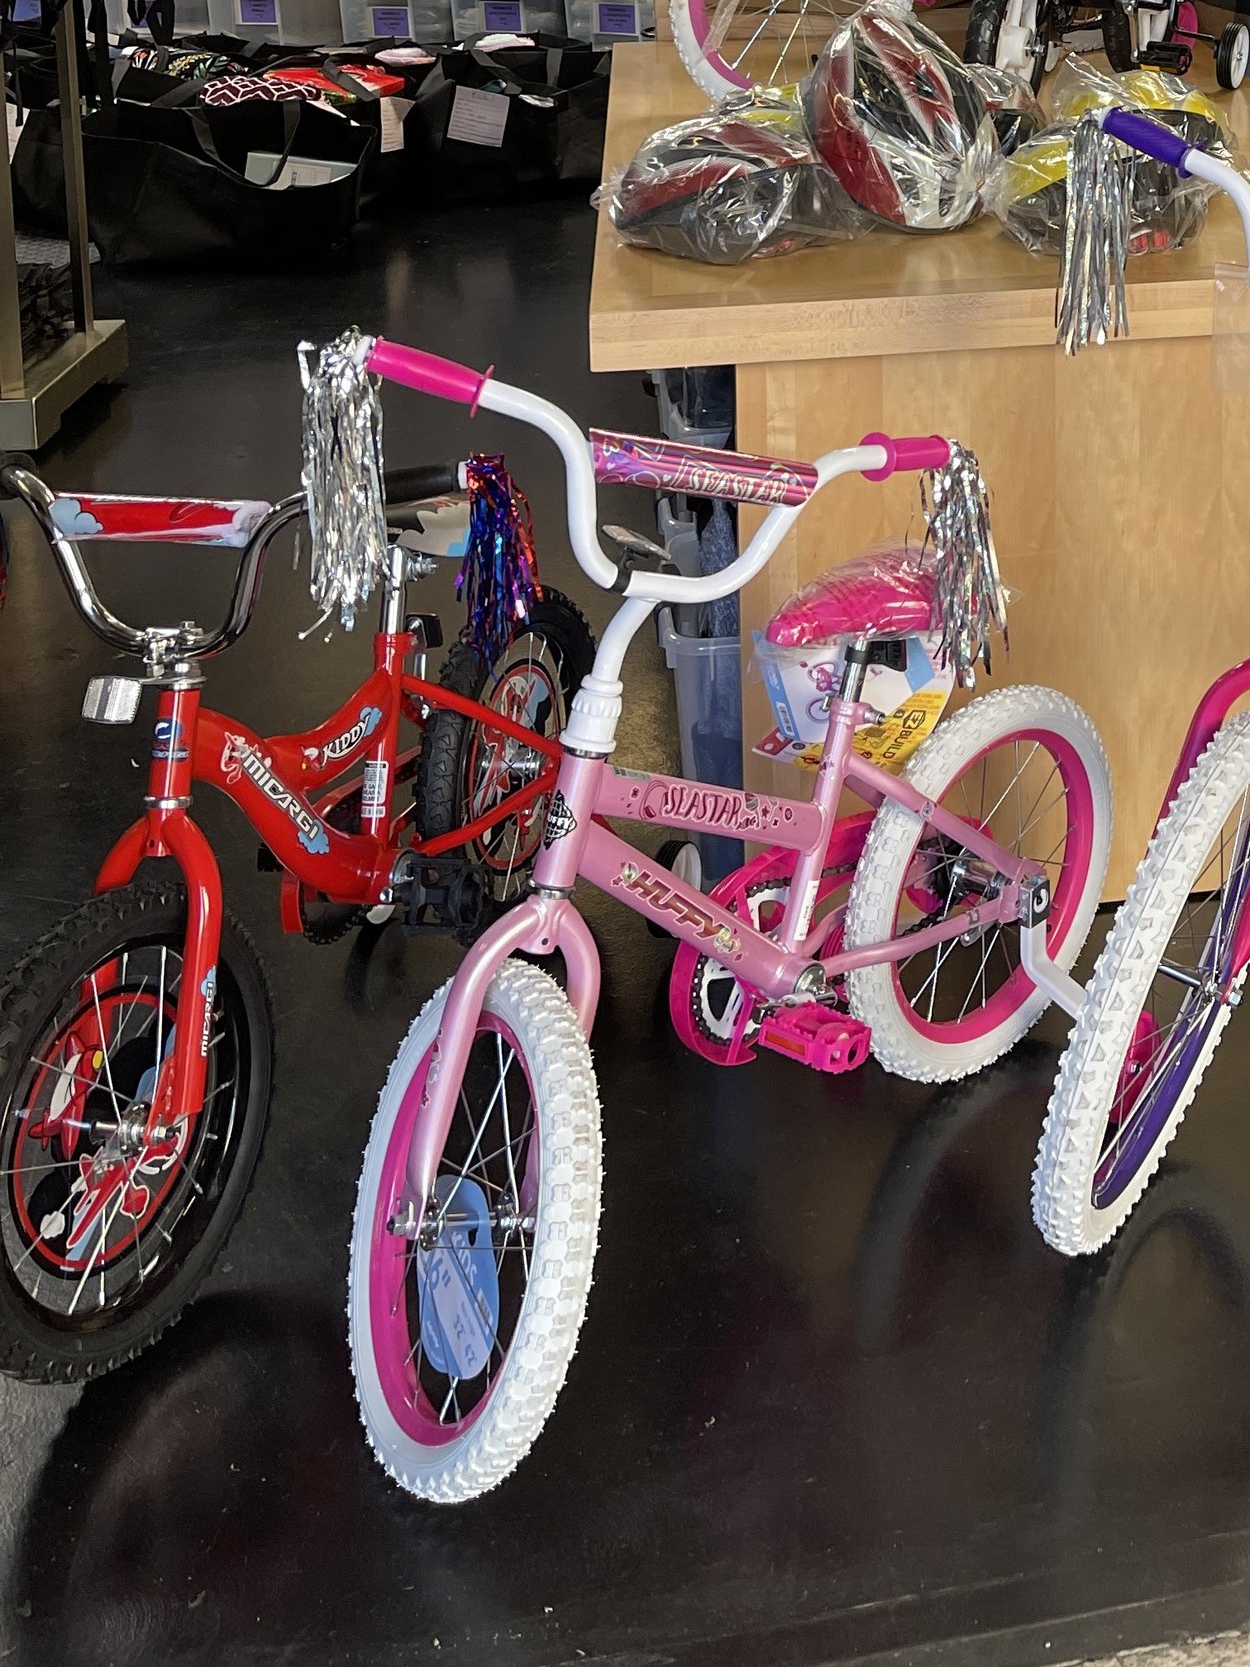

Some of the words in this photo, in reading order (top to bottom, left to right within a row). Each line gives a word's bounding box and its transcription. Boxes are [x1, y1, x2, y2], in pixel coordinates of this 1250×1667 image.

[321, 712, 371, 767] KIDDY
[883, 730, 912, 759] BUILD
[242, 752, 320, 840] MICARGI
[663, 784, 743, 829] SEASTAR
[627, 869, 726, 939] HUFFY
